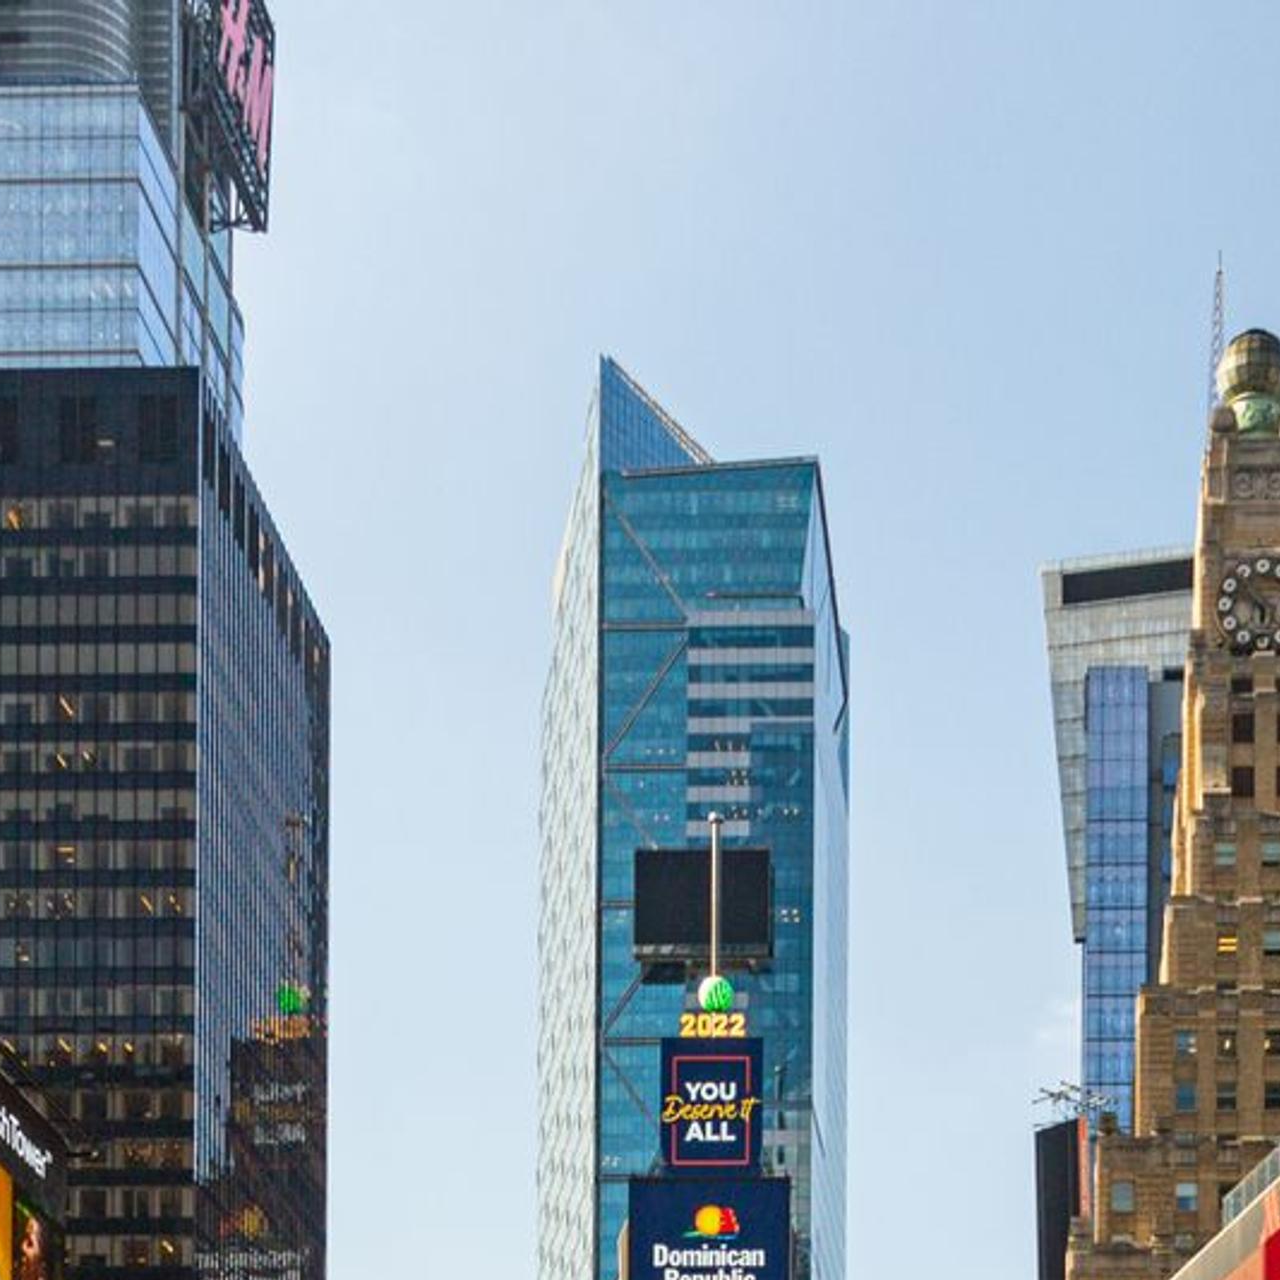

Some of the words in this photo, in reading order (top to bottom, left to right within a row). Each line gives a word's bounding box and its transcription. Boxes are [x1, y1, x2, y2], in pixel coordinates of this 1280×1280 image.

[680, 1013, 745, 1037] 2022
[685, 1082, 736, 1101] YOU
[662, 1094, 737, 1122] Deserve
[685, 1121, 736, 1141] ALL
[653, 1243, 765, 1267] Dominican
